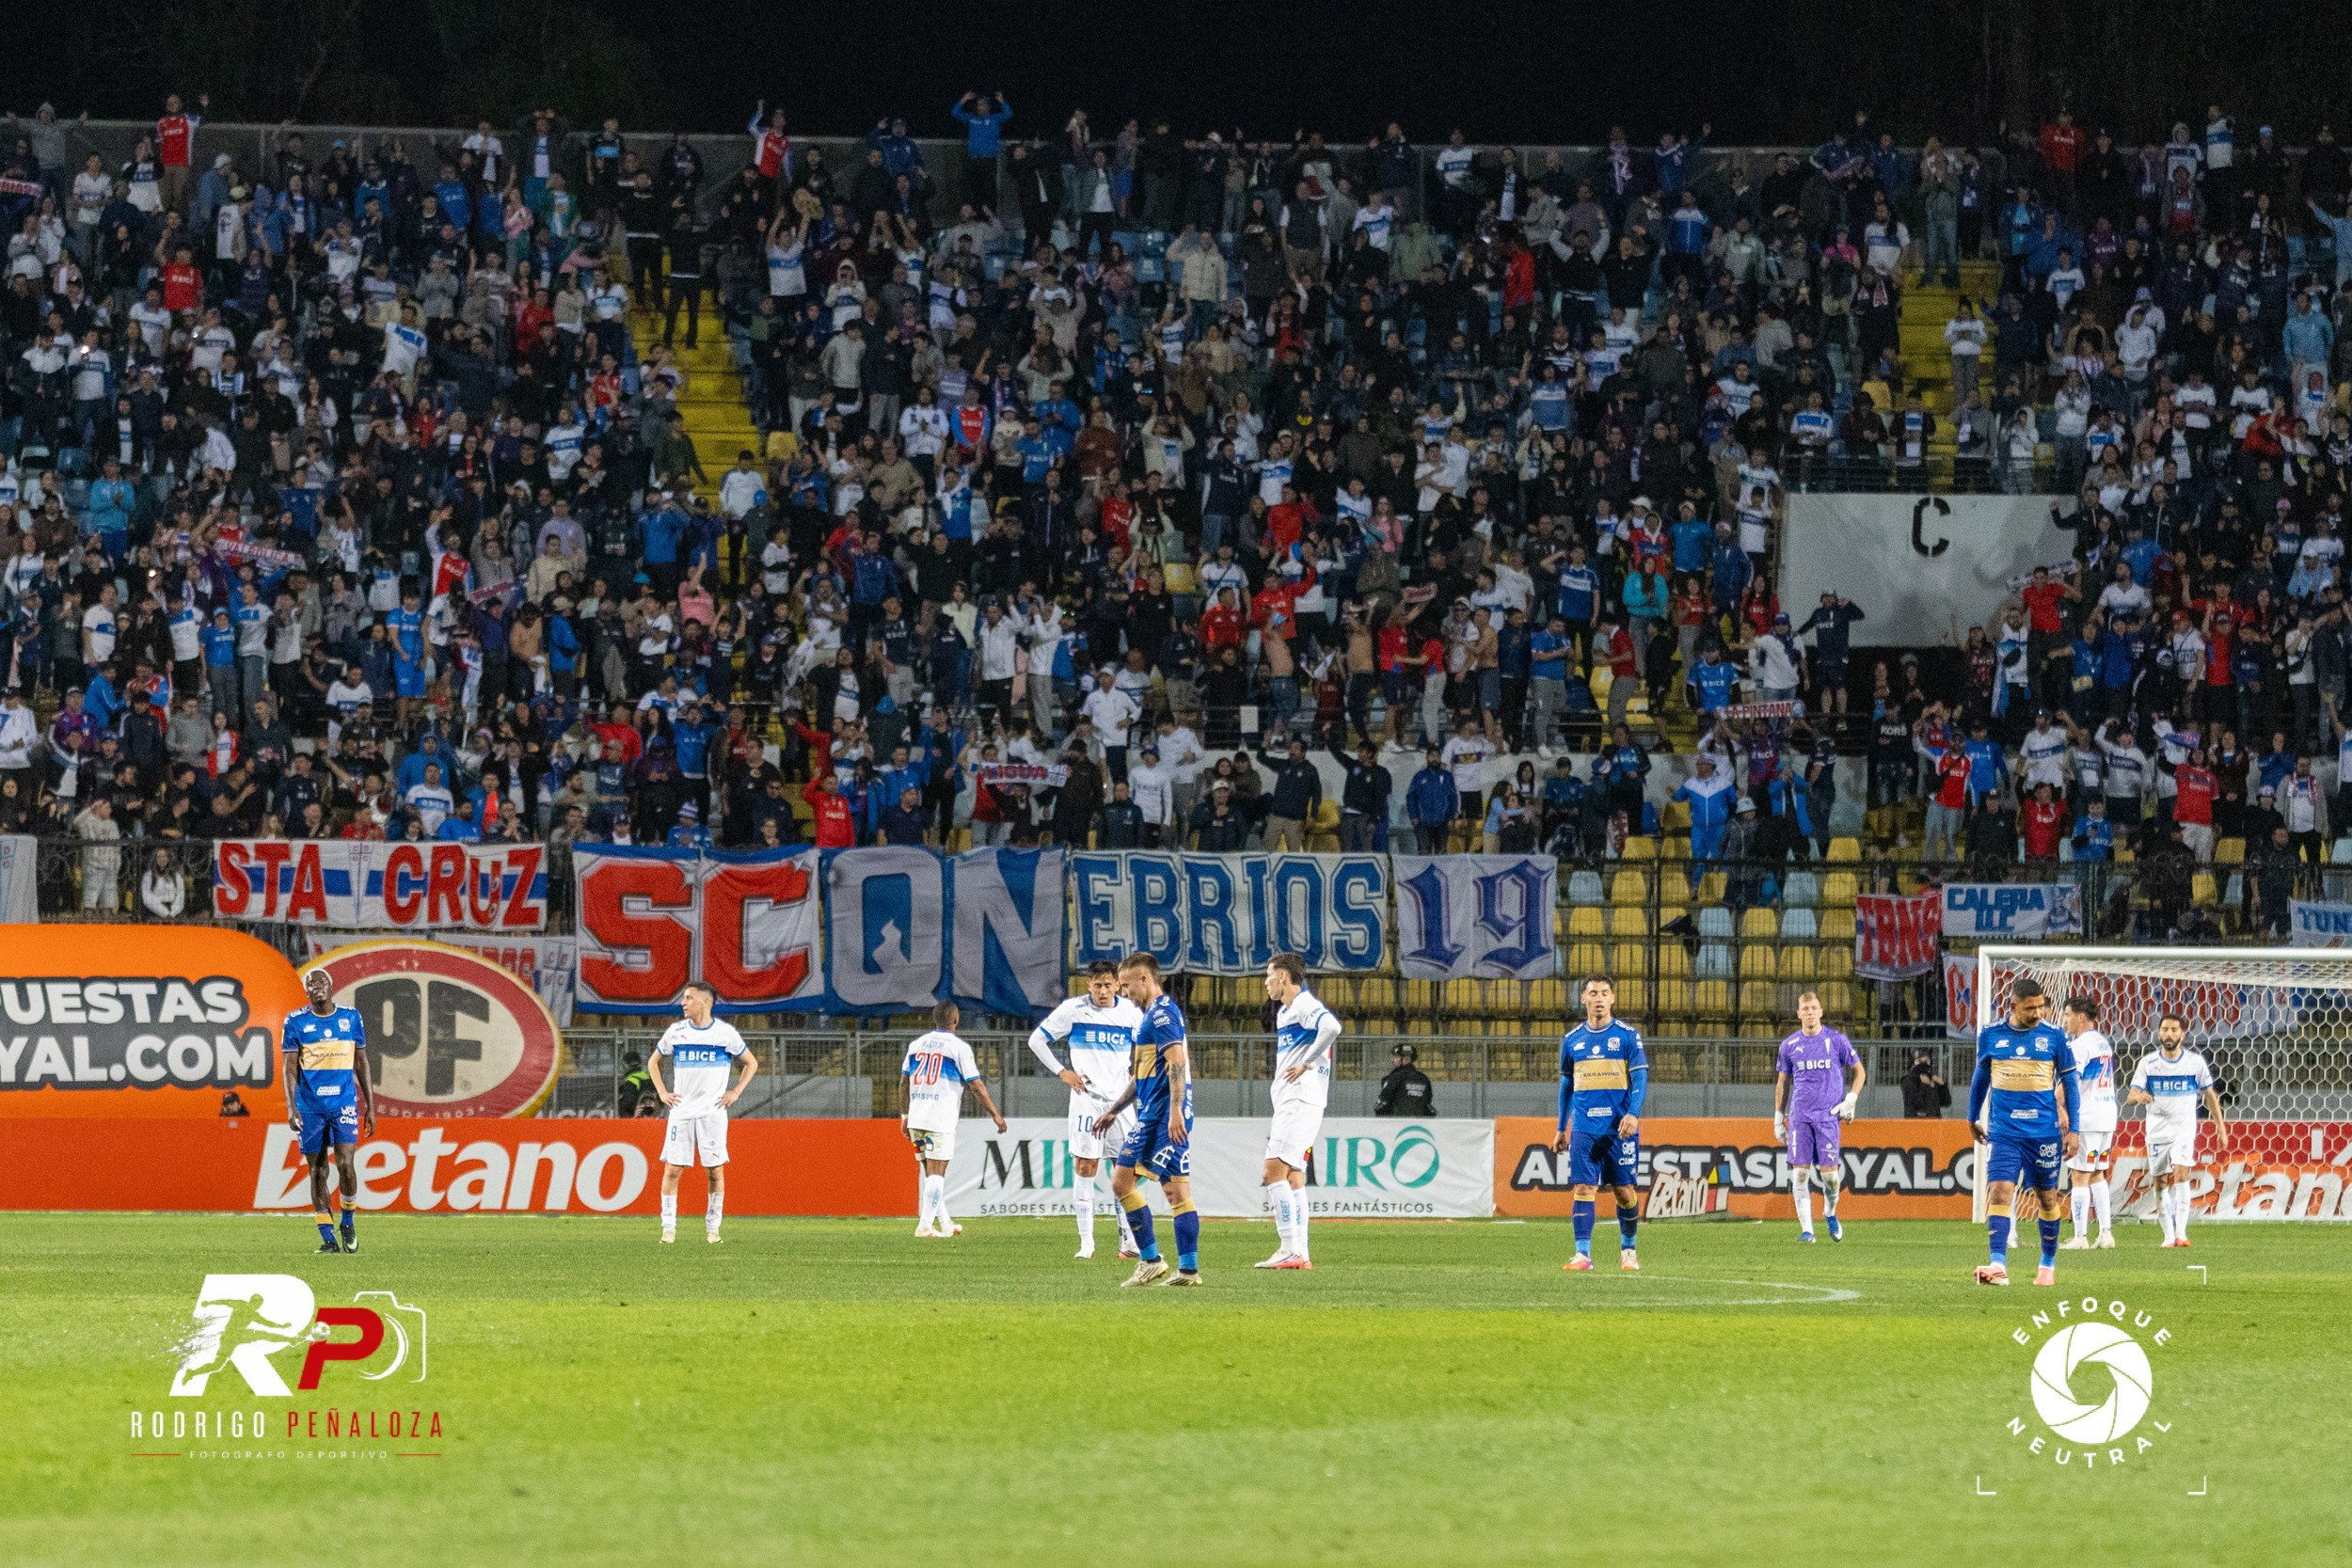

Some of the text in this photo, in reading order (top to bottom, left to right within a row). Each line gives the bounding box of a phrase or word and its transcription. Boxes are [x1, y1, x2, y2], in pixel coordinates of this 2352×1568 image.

[1912, 497, 1951, 557] C
[216, 842, 543, 928] STA CRUZ
[1073, 852, 1387, 974] EBRIOS
[1947, 888, 2045, 911] CALERA
[1396, 859, 1556, 974] 19
[0, 981, 242, 1025] UESTAS
[355, 977, 490, 1097] PF
[1098, 1031, 1126, 1046] BICE
[688, 1050, 717, 1063] BICE
[914, 1053, 942, 1086] 20
[1805, 1058, 1832, 1070] BICE
[2162, 1081, 2188, 1092] BICE
[670, 1126, 676, 1142] 8
[1077, 1114, 1093, 1132] 10
[253, 1123, 649, 1212] Betano
[2109, 1156, 2352, 1217] Betan
[979, 1203, 1046, 1214] SABORES
[1334, 1198, 1434, 1214] FANTÁSTICOS
